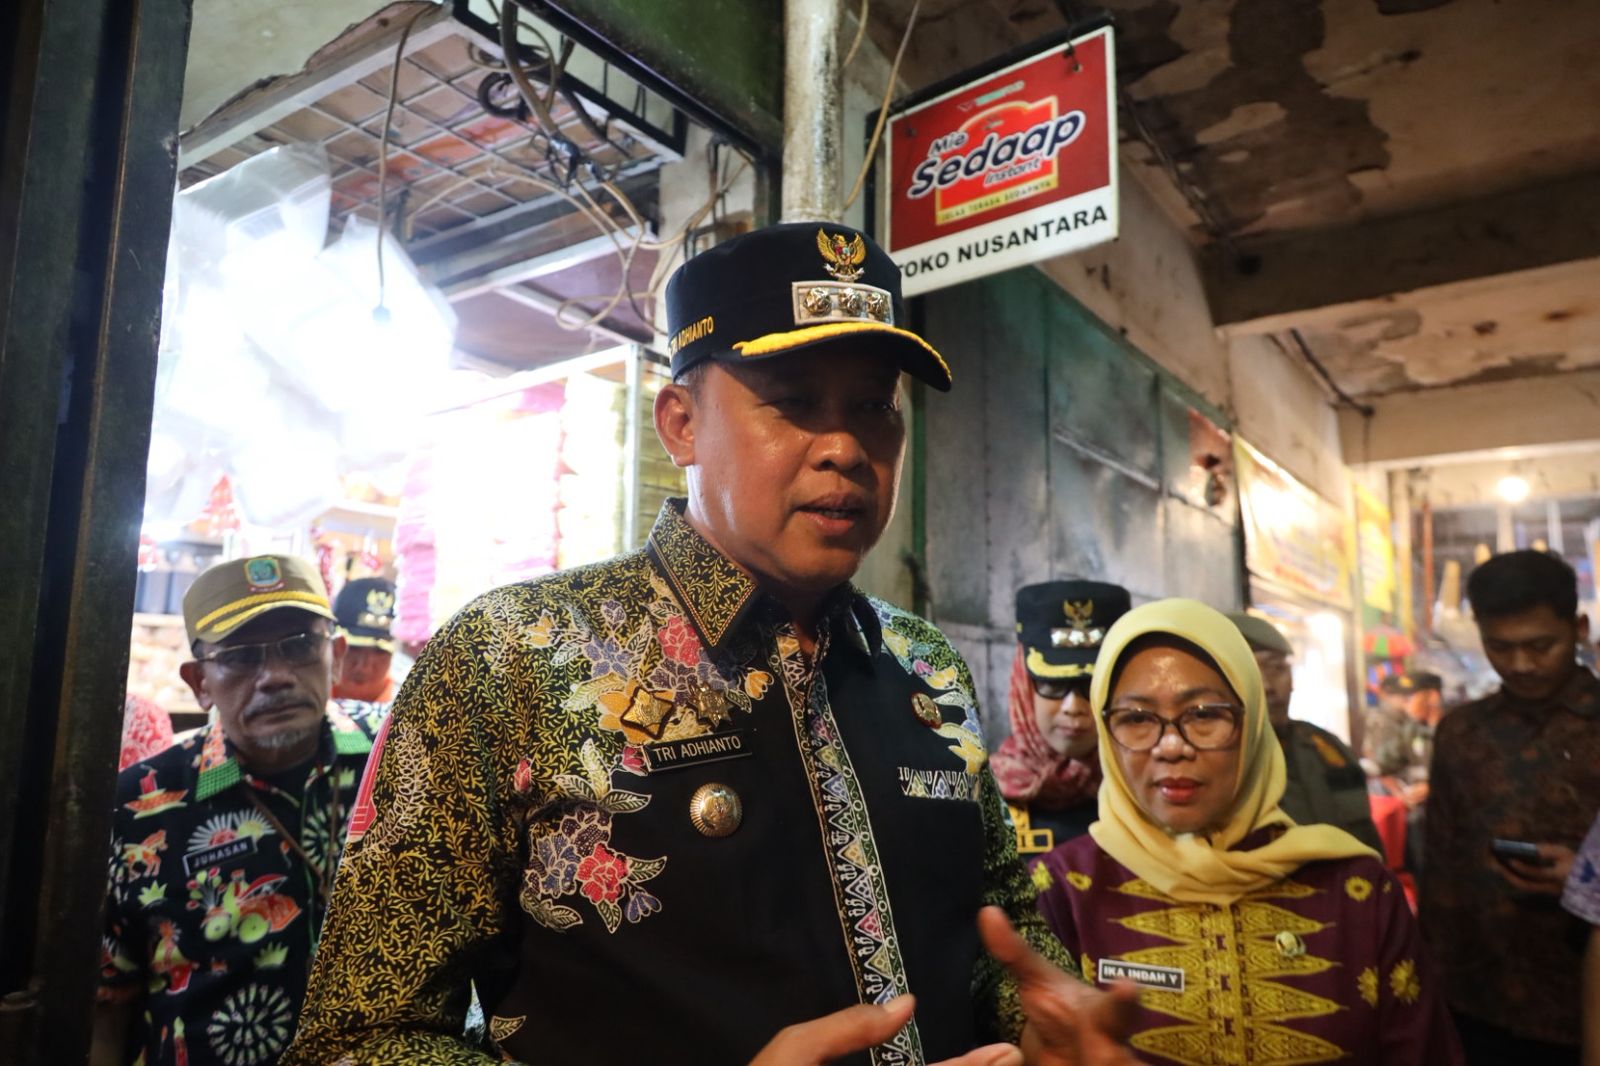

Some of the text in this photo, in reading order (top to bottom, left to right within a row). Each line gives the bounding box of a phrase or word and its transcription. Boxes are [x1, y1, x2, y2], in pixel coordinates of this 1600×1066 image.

[908, 110, 1086, 198] Sedaap
[929, 131, 968, 157] Mie
[958, 205, 1108, 263] NUSANTARA
[653, 735, 741, 762] TRI ADHIANTO
[1103, 965, 1178, 985] IKA INDAH Y
